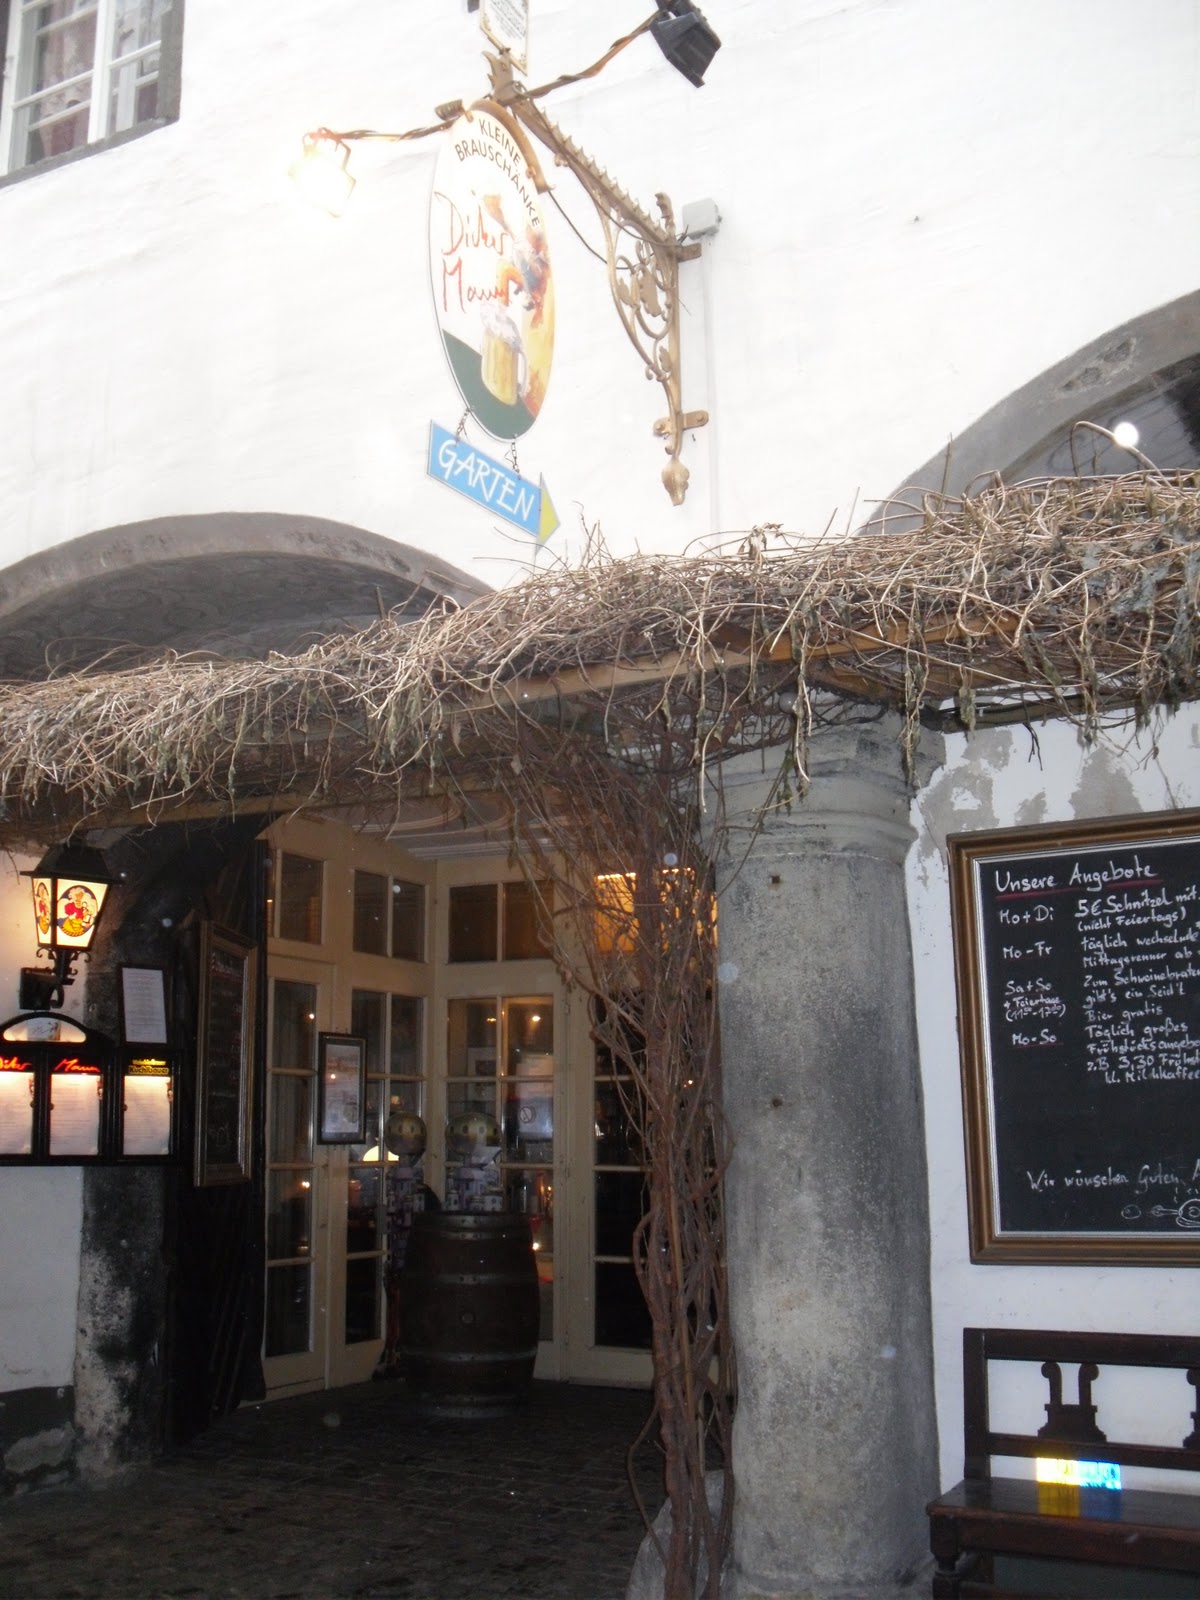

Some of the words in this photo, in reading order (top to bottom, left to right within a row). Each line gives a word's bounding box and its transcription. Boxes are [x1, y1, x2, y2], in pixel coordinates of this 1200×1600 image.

[479, 118, 521, 166] KLEINE
[455, 138, 540, 227] BRAUSCHÄNKE
[438, 439, 535, 522] GARTEN
[995, 869, 1057, 893] Unsere
[1069, 855, 1158, 891] Angebote
[1081, 932, 1127, 954] täglich
[1175, 945, 1193, 959] ab
[1084, 1009, 1113, 1022] Bier
[1120, 1000, 1163, 1025] gratis
[1026, 1169, 1055, 1192] Wir
[1135, 1163, 1179, 1195] Guten
